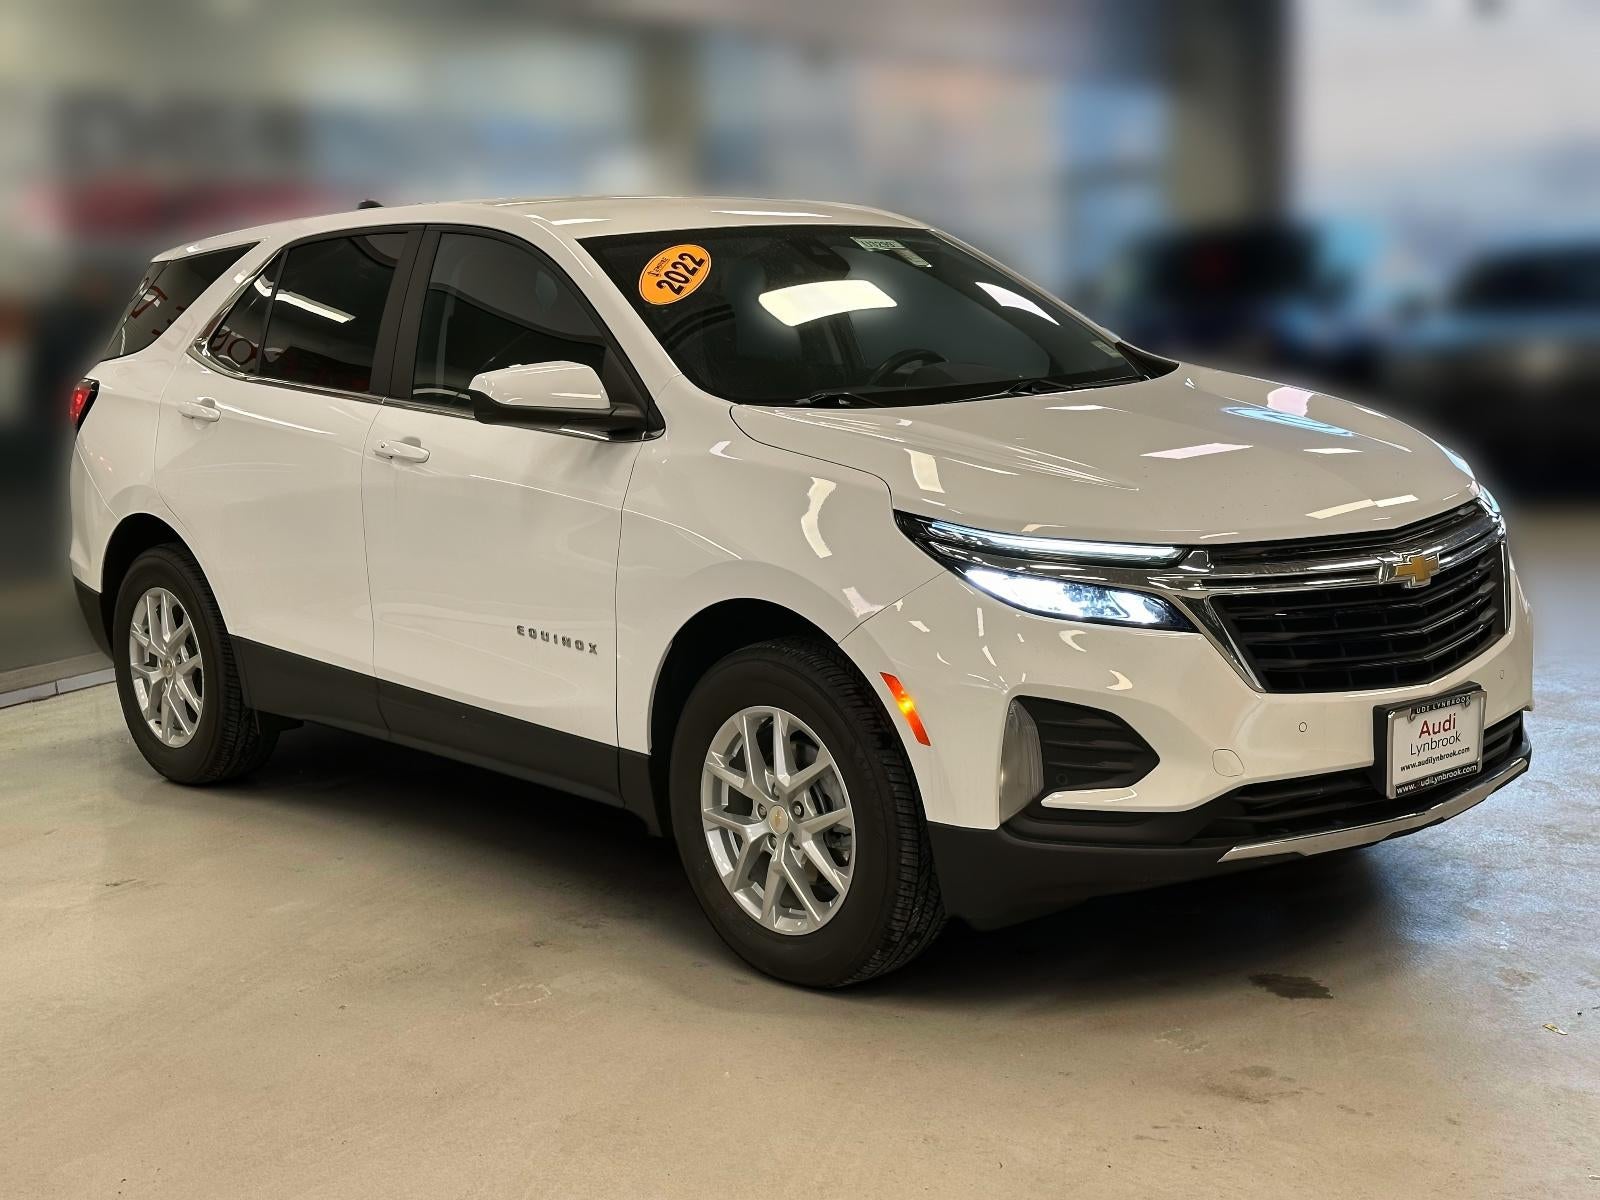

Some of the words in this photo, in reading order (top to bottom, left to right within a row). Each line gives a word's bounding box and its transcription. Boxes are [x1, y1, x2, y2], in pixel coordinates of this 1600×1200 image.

[656, 253, 705, 295] 2022
[516, 625, 598, 655] EQUINOX
[1419, 713, 1456, 738] Audi
[1409, 731, 1461, 756] Lynbrook
[1400, 747, 1470, 772] www.audilynbrook.com
